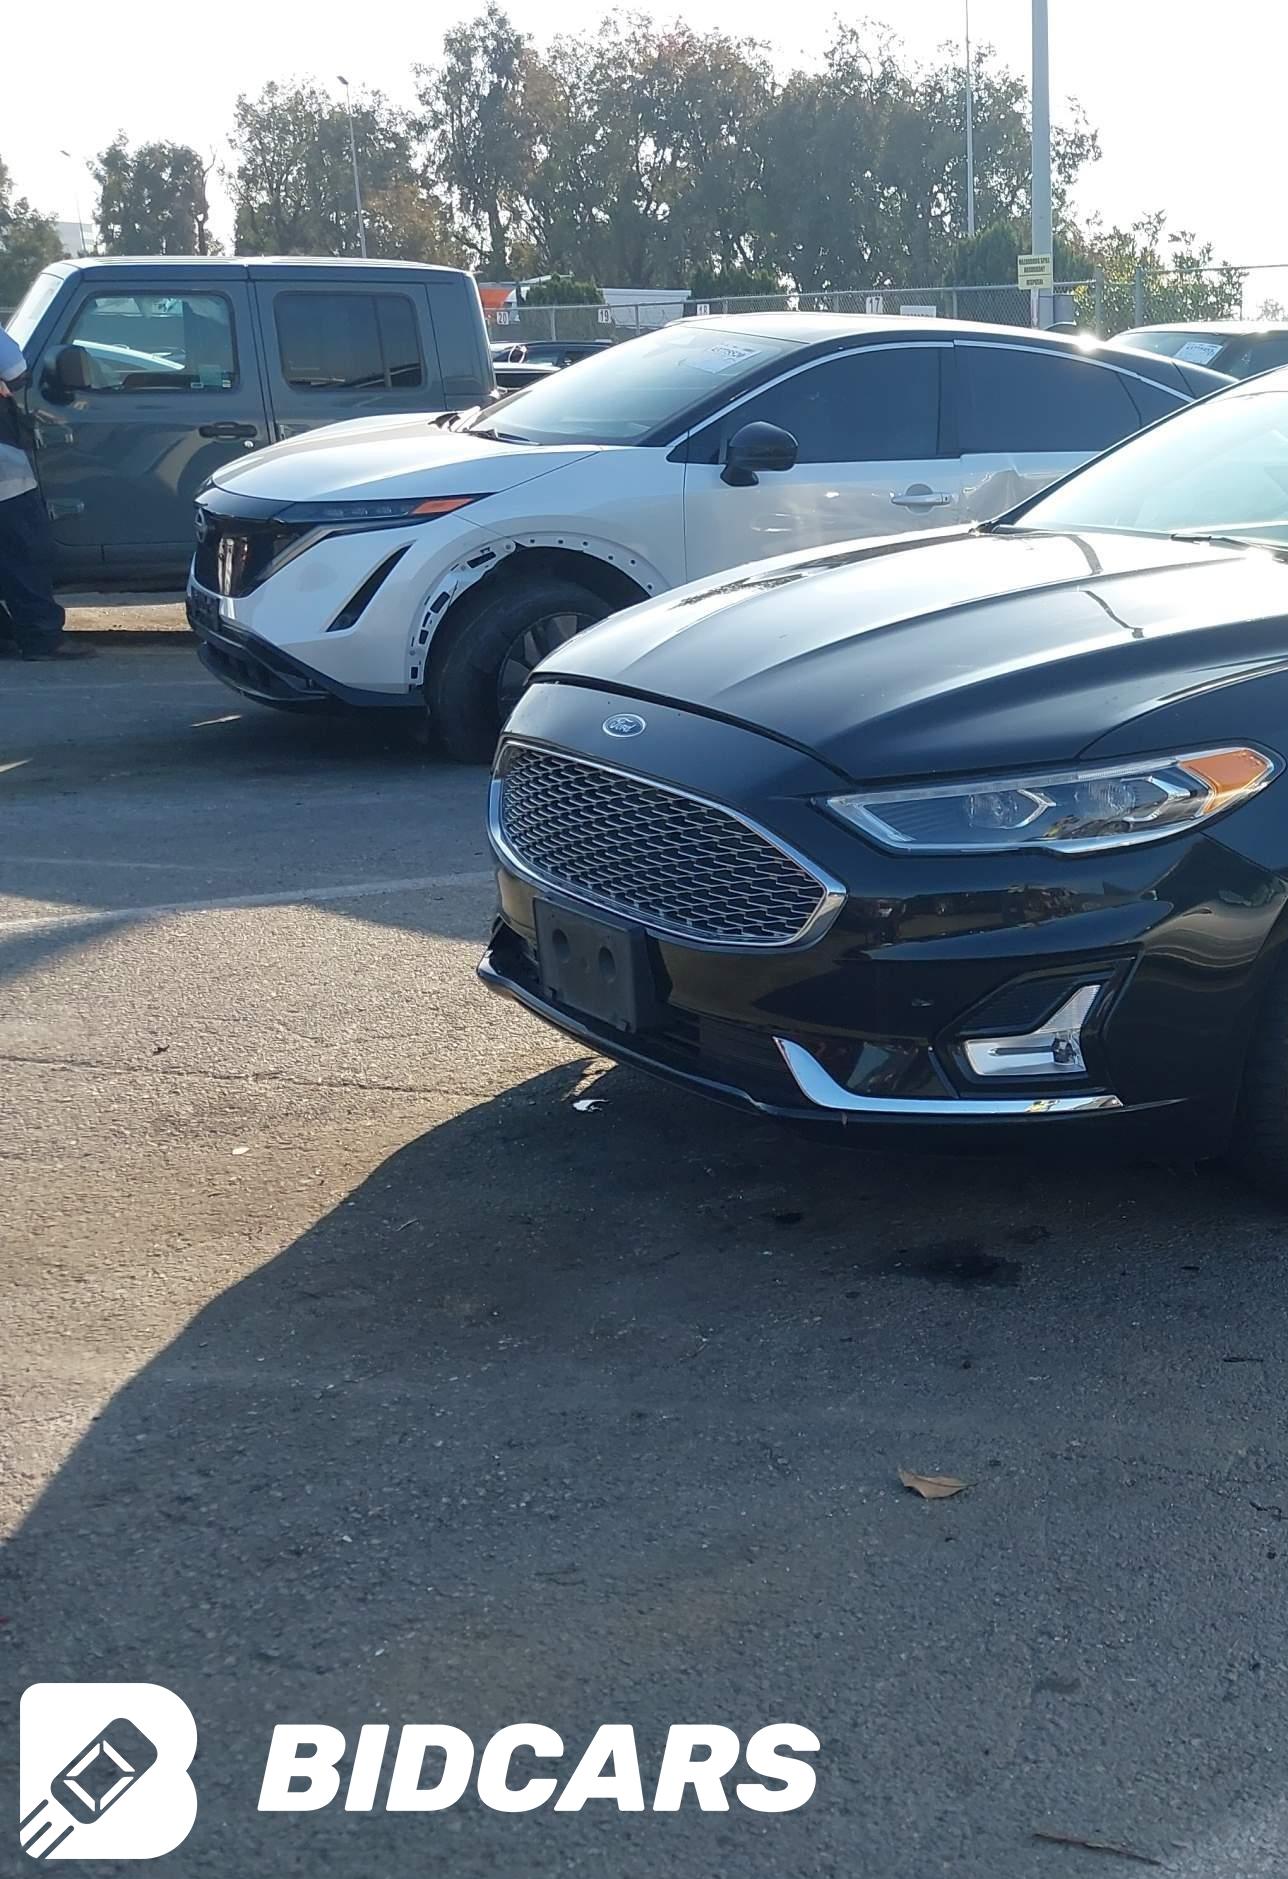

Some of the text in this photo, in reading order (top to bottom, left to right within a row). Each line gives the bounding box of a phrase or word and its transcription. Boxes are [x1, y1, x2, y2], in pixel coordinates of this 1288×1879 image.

[869, 297, 881, 313] 17
[498, 312, 508, 324] 20
[600, 311, 609, 322] 19
[608, 716, 639, 733] Ford
